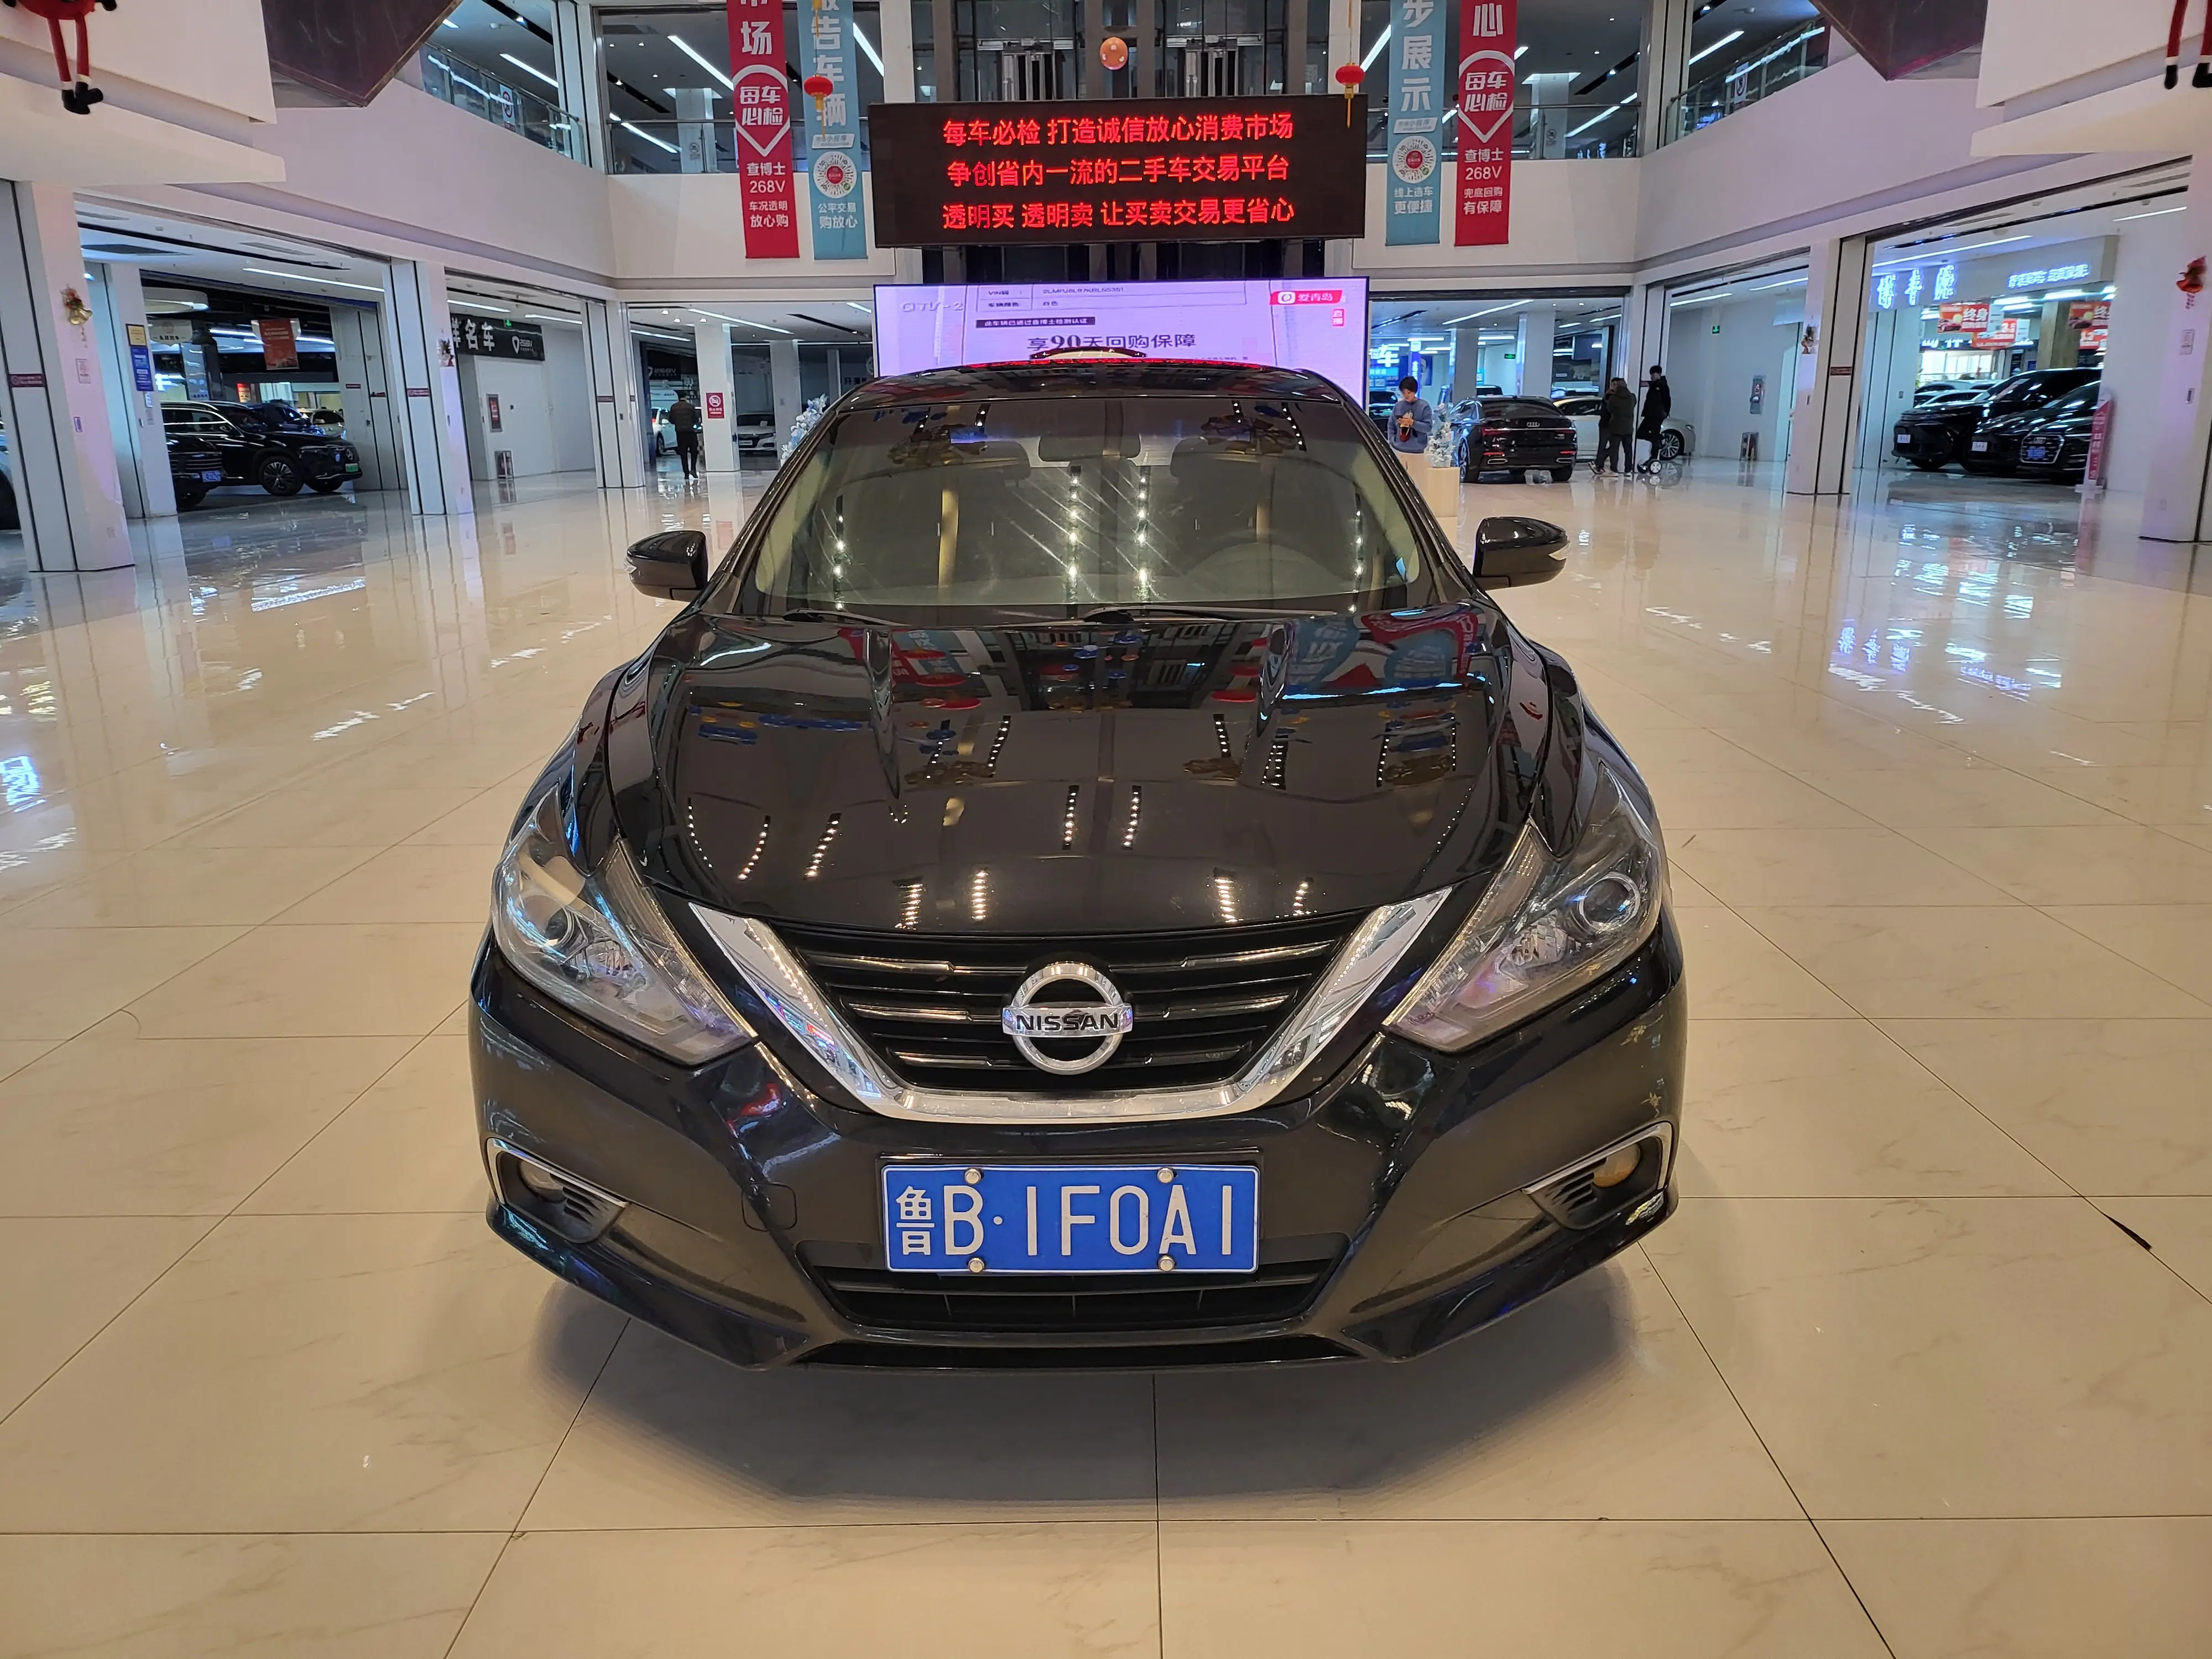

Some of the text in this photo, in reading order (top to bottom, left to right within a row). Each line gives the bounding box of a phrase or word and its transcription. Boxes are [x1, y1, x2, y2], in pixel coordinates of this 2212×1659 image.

[740, 0, 772, 54] 场
[1473, 3, 1504, 36] 心
[1465, 71, 1508, 90] 每车
[740, 86, 781, 104] 每车
[1464, 92, 1507, 112] 必检
[742, 107, 783, 126] 必检
[943, 113, 1293, 146] 每车必检 打造诚信放心消费市场
[1464, 148, 1504, 163] 查博士
[747, 161, 786, 176] 查博士
[947, 154, 1289, 187] 争创省内一流的二手车交易平台
[1465, 166, 1502, 180] 268V
[749, 180, 785, 193] 268V
[749, 201, 787, 211] 车况透明
[818, 202, 856, 213] 公平交易
[942, 197, 1295, 229] 透明买 透明卖 让买卖交易更省心
[1394, 199, 1433, 215] 更便捷
[1463, 200, 1503, 215] 有保障
[750, 214, 789, 228] 放心购
[819, 216, 858, 229] 购放心
[1027, 334, 1196, 351] 享90天回购保障
[1016, 1013, 1118, 1031] NISSAN
